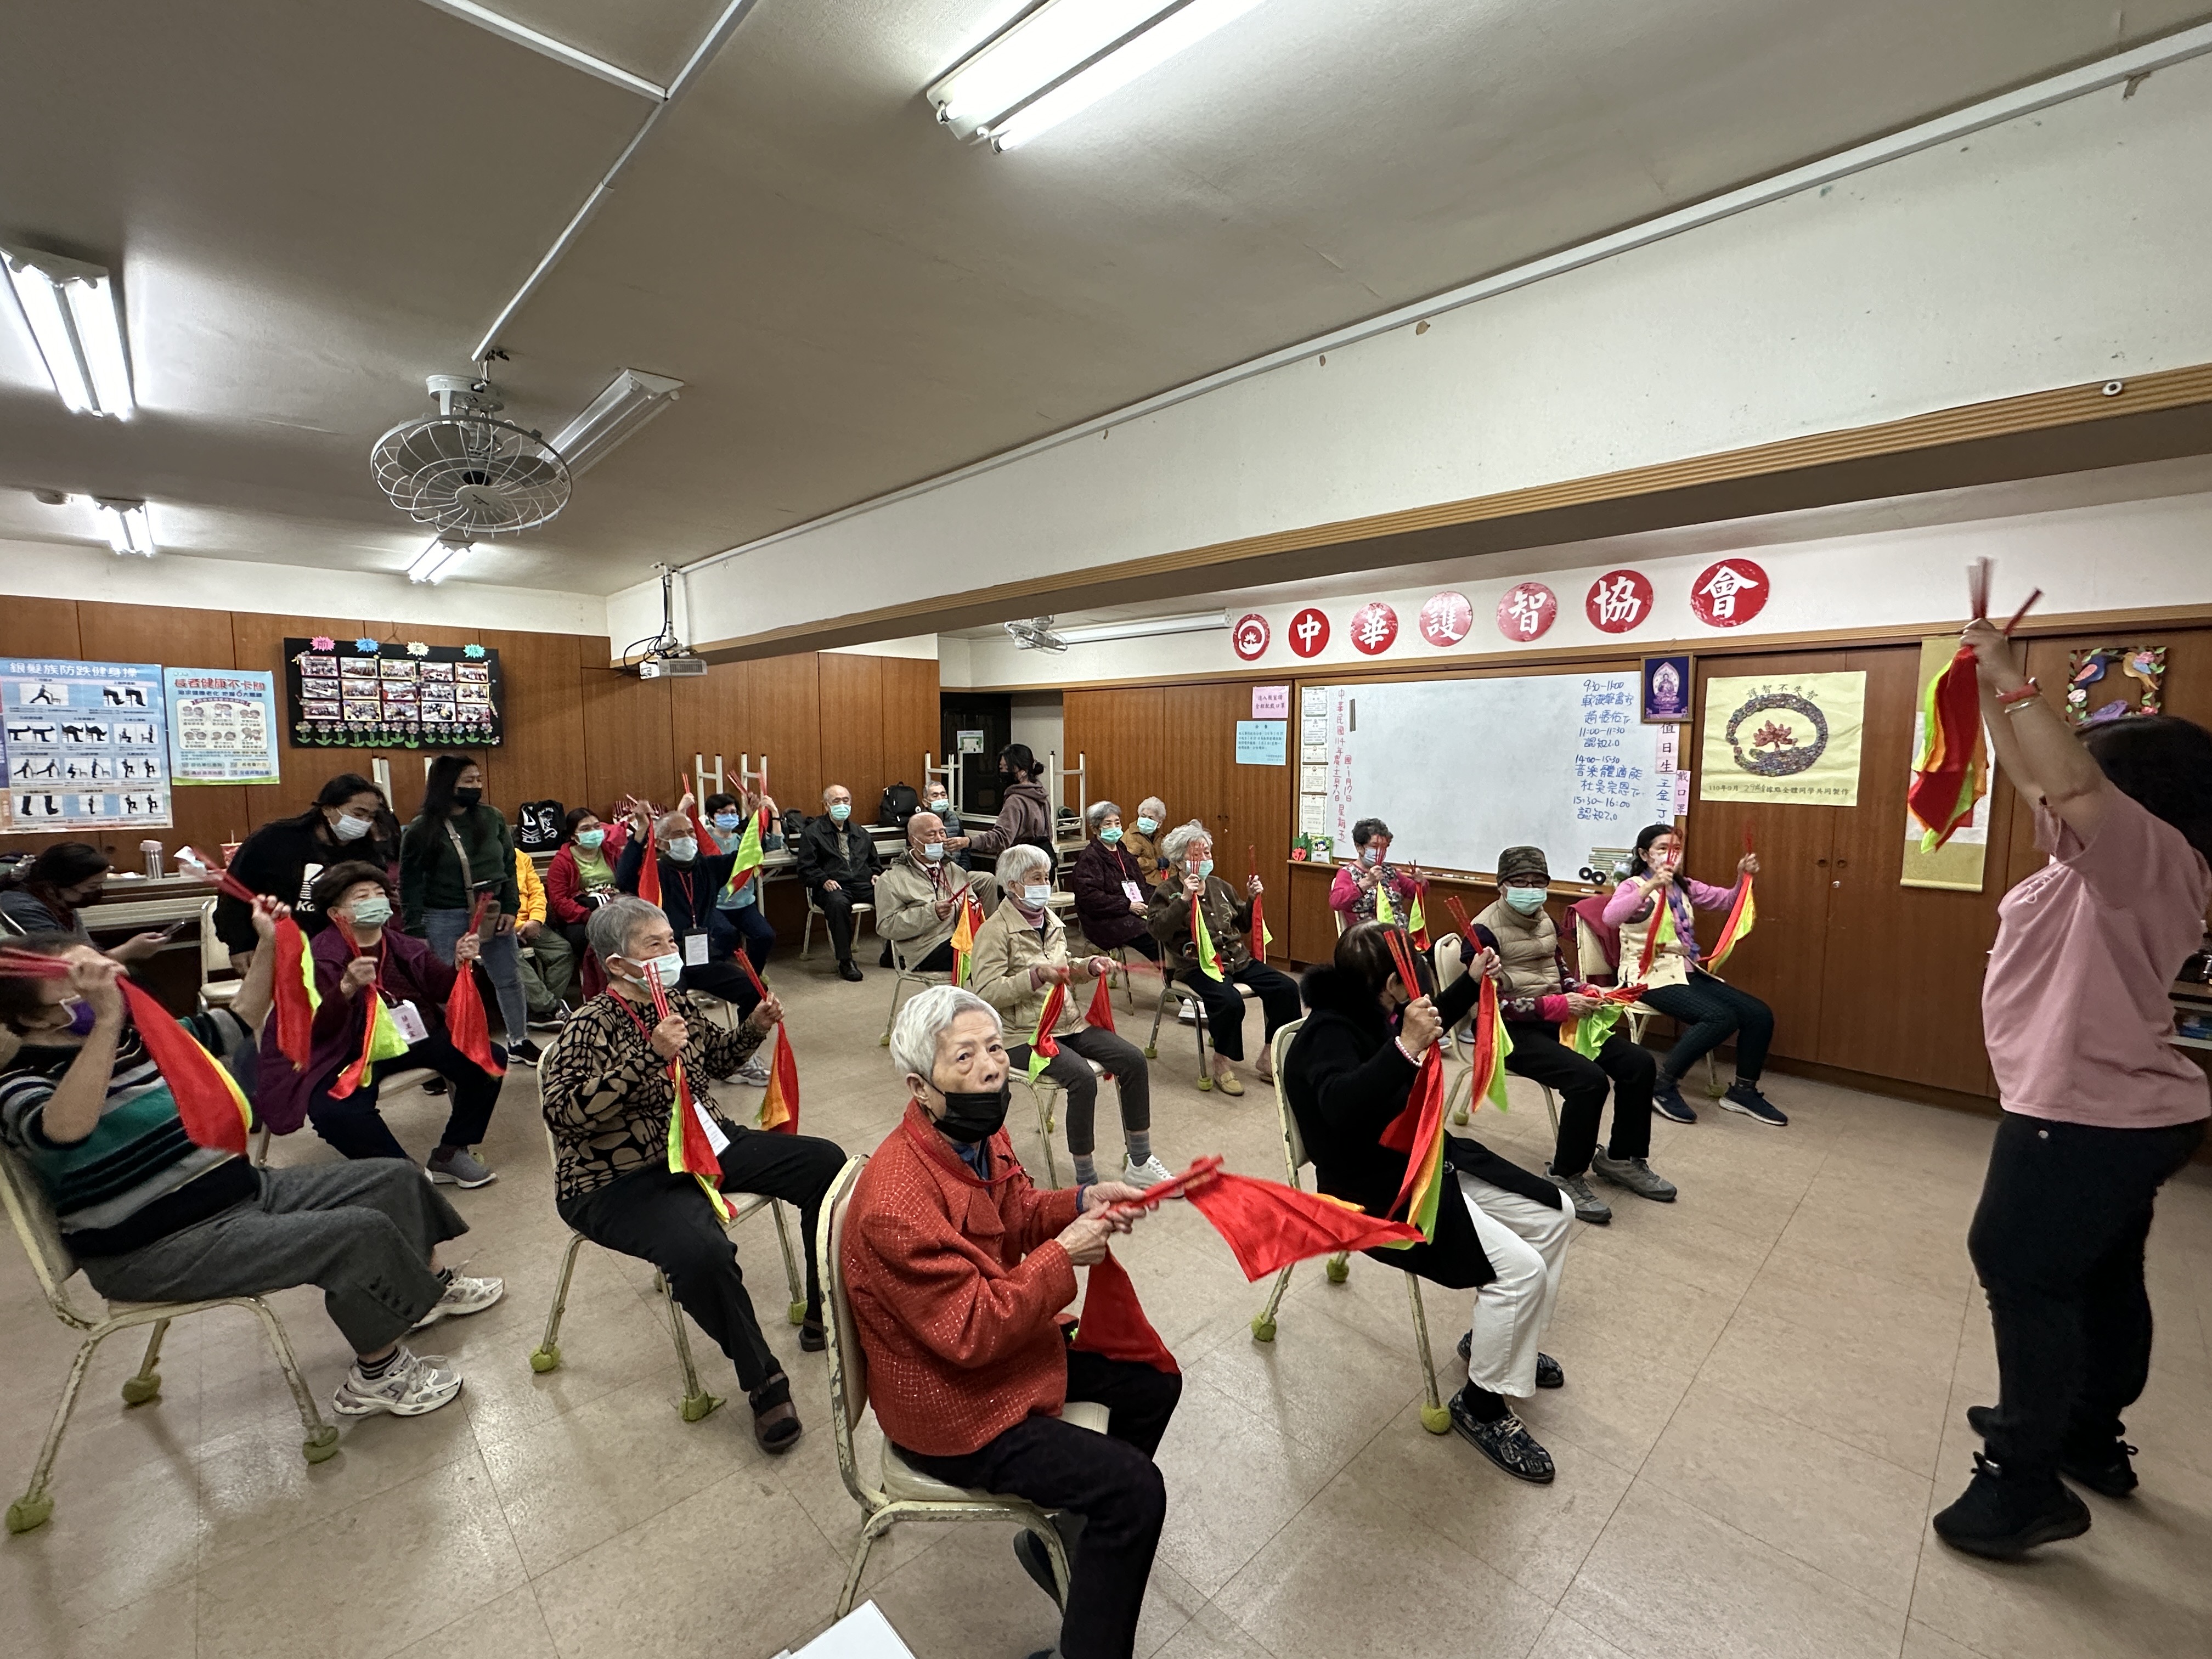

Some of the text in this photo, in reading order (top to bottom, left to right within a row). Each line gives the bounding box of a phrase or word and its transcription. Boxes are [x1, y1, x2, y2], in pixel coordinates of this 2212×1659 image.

[1296, 565, 1759, 652] 中華護智協會
[10, 662, 137, 678] 銀髮族防跌健身操
[174, 678, 266, 691] 長者健康不卡關
[1660, 723, 1676, 772] 值日生
[1675, 771, 1689, 814] 戴口罩
[1338, 804, 1346, 843] 星期五
